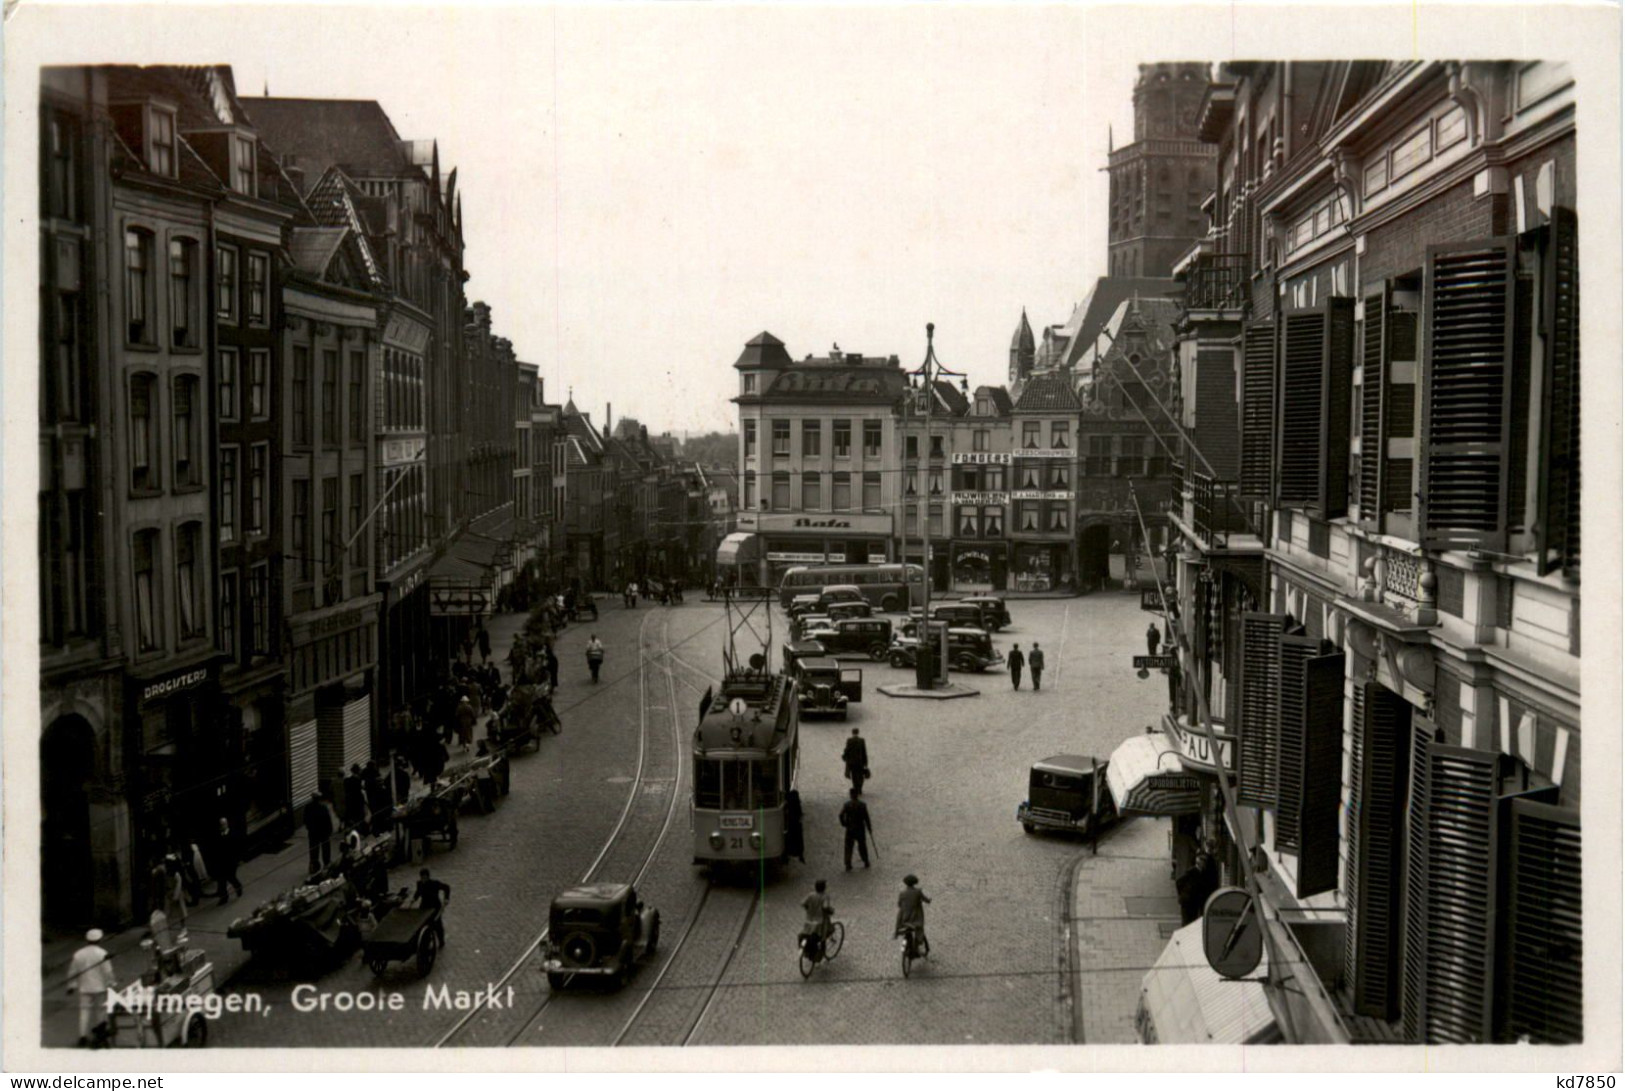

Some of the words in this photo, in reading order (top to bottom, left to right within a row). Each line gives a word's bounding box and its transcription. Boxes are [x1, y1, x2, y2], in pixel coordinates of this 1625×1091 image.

[793, 518, 851, 528] Bata
[735, 702, 741, 714] 1
[731, 838, 743, 849] 21
